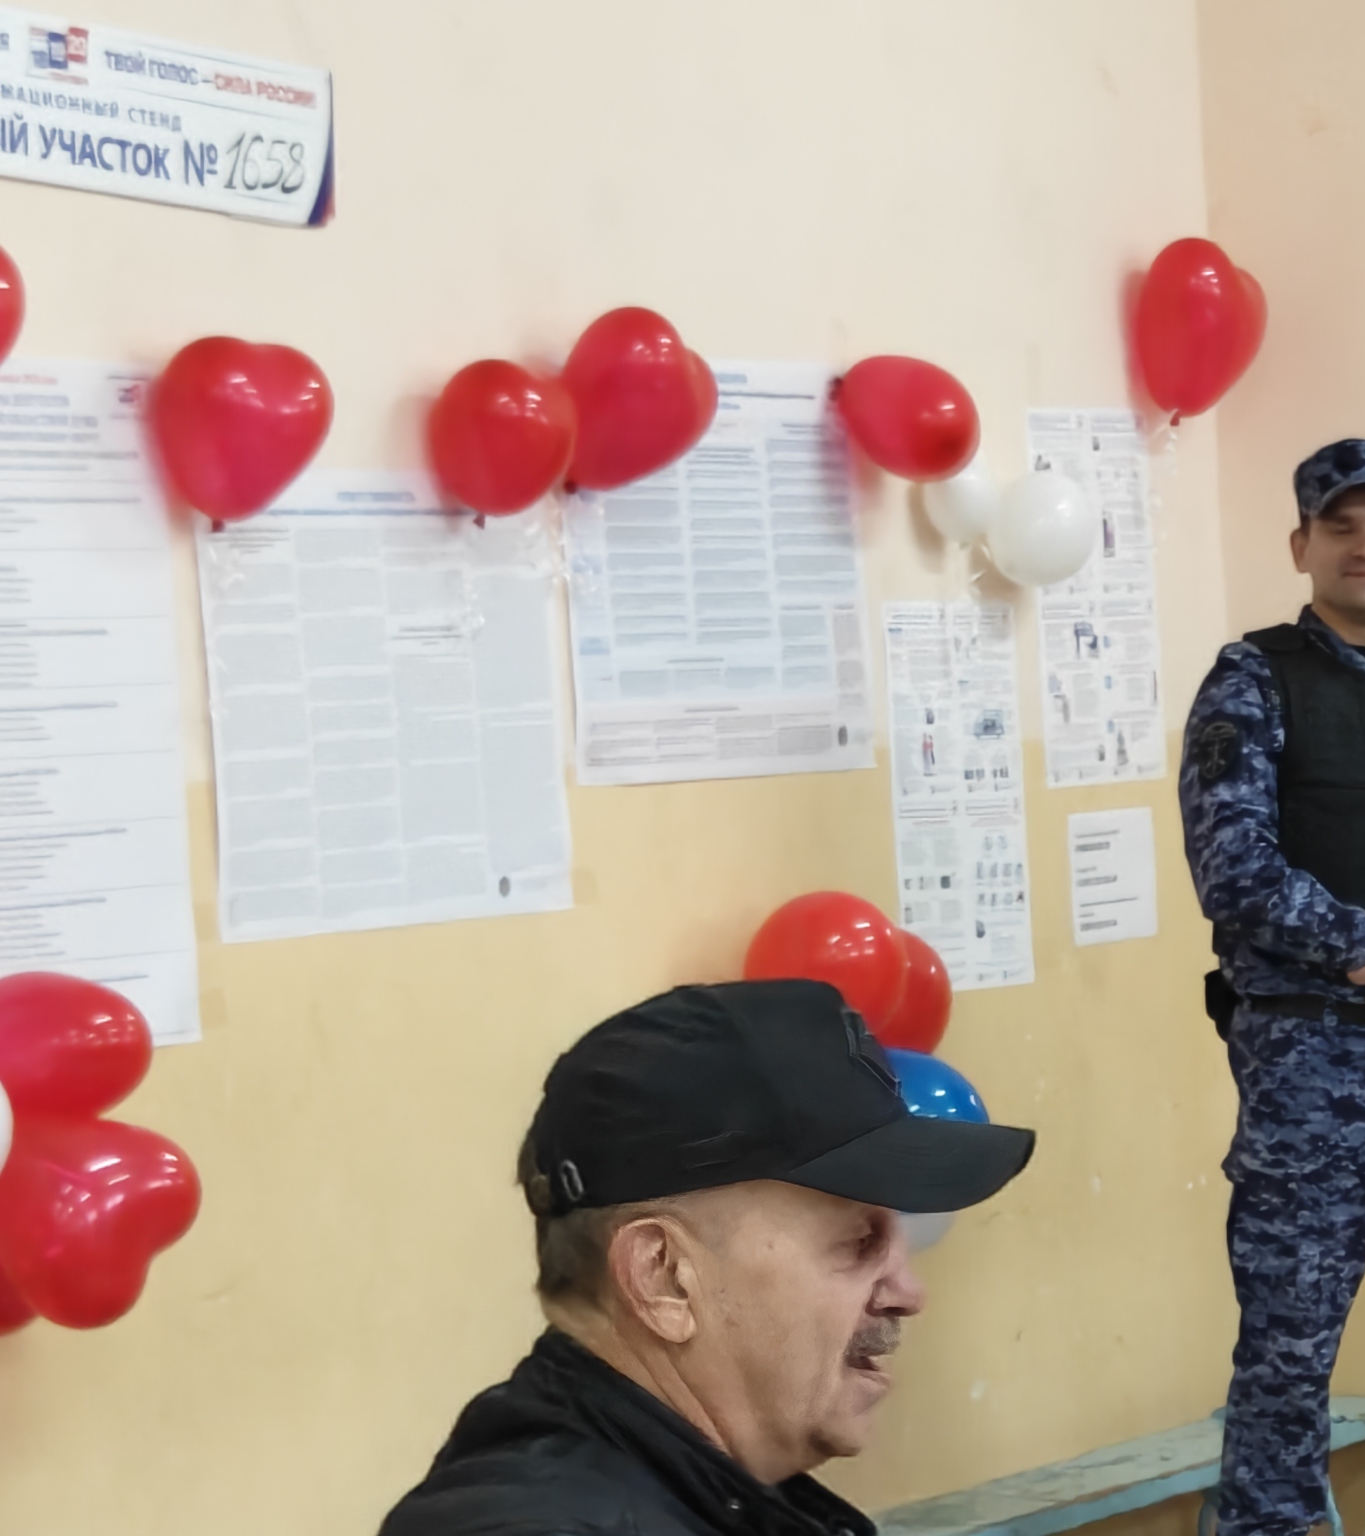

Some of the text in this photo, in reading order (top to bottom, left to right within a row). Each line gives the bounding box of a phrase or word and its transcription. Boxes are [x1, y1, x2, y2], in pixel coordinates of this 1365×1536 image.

[39, 124, 171, 181] УЧАСТОК
[184, 139, 218, 187] №
[223, 131, 304, 194] 1658
